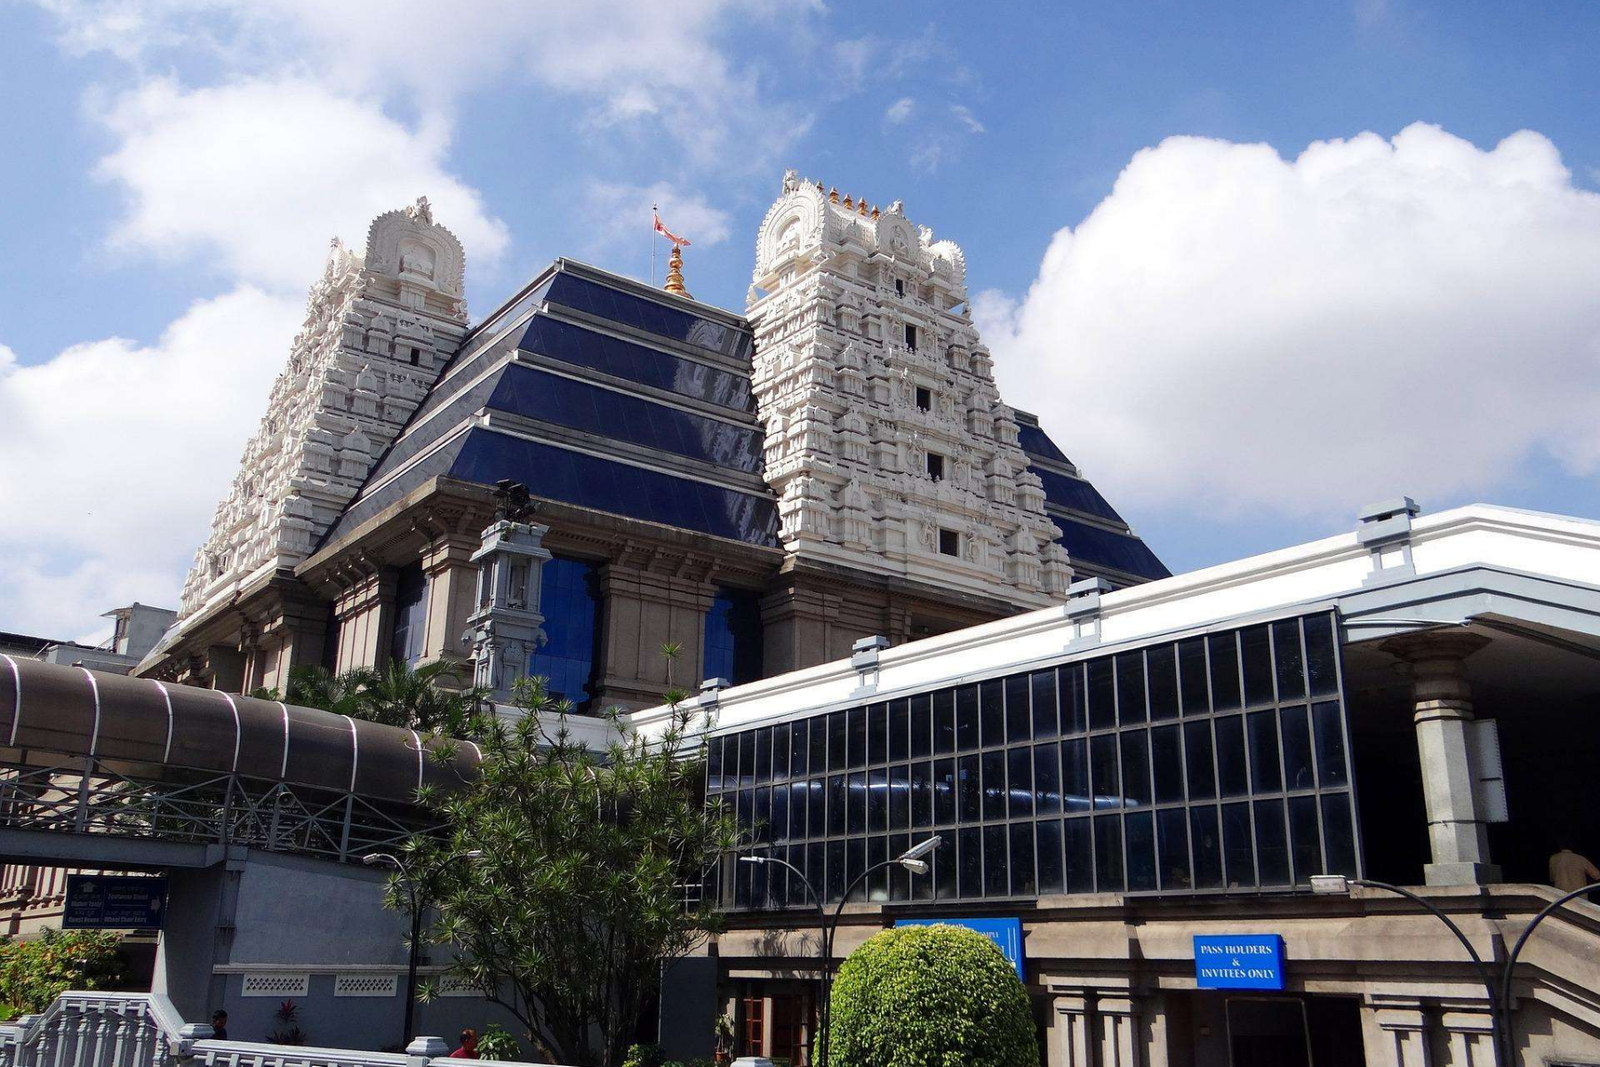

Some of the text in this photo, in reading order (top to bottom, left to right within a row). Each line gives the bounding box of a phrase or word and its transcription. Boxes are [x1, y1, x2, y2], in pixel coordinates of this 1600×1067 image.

[1200, 945, 1273, 955] PASS HOLDERS
[1231, 957, 1241, 967] &
[1201, 968, 1275, 979] INVITEES ONLY
